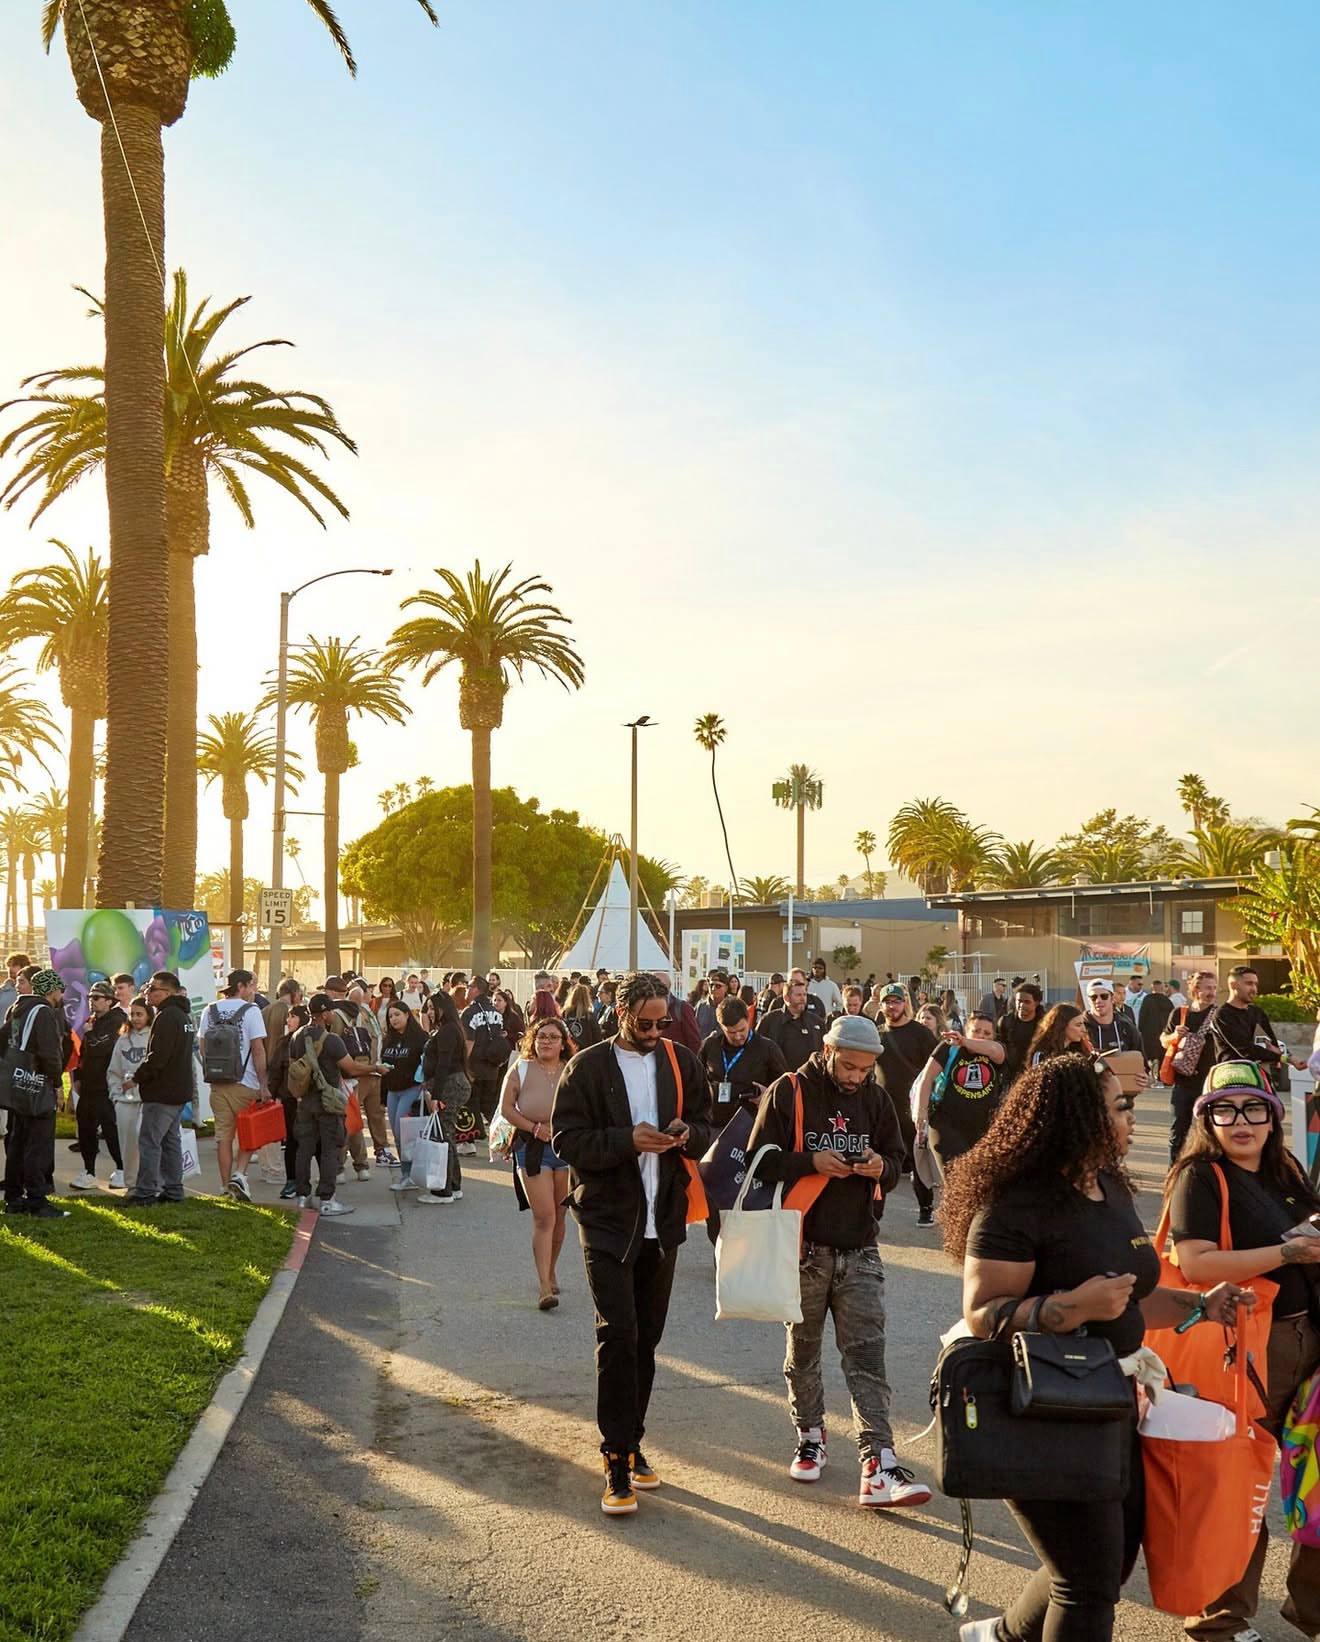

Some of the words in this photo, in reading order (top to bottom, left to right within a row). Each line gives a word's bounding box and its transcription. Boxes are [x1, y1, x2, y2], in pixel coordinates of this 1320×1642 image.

[263, 891, 290, 899] SPEED
[265, 909, 286, 924] 15
[804, 1131, 871, 1153] CADRE
[1250, 1479, 1272, 1535] HALL
